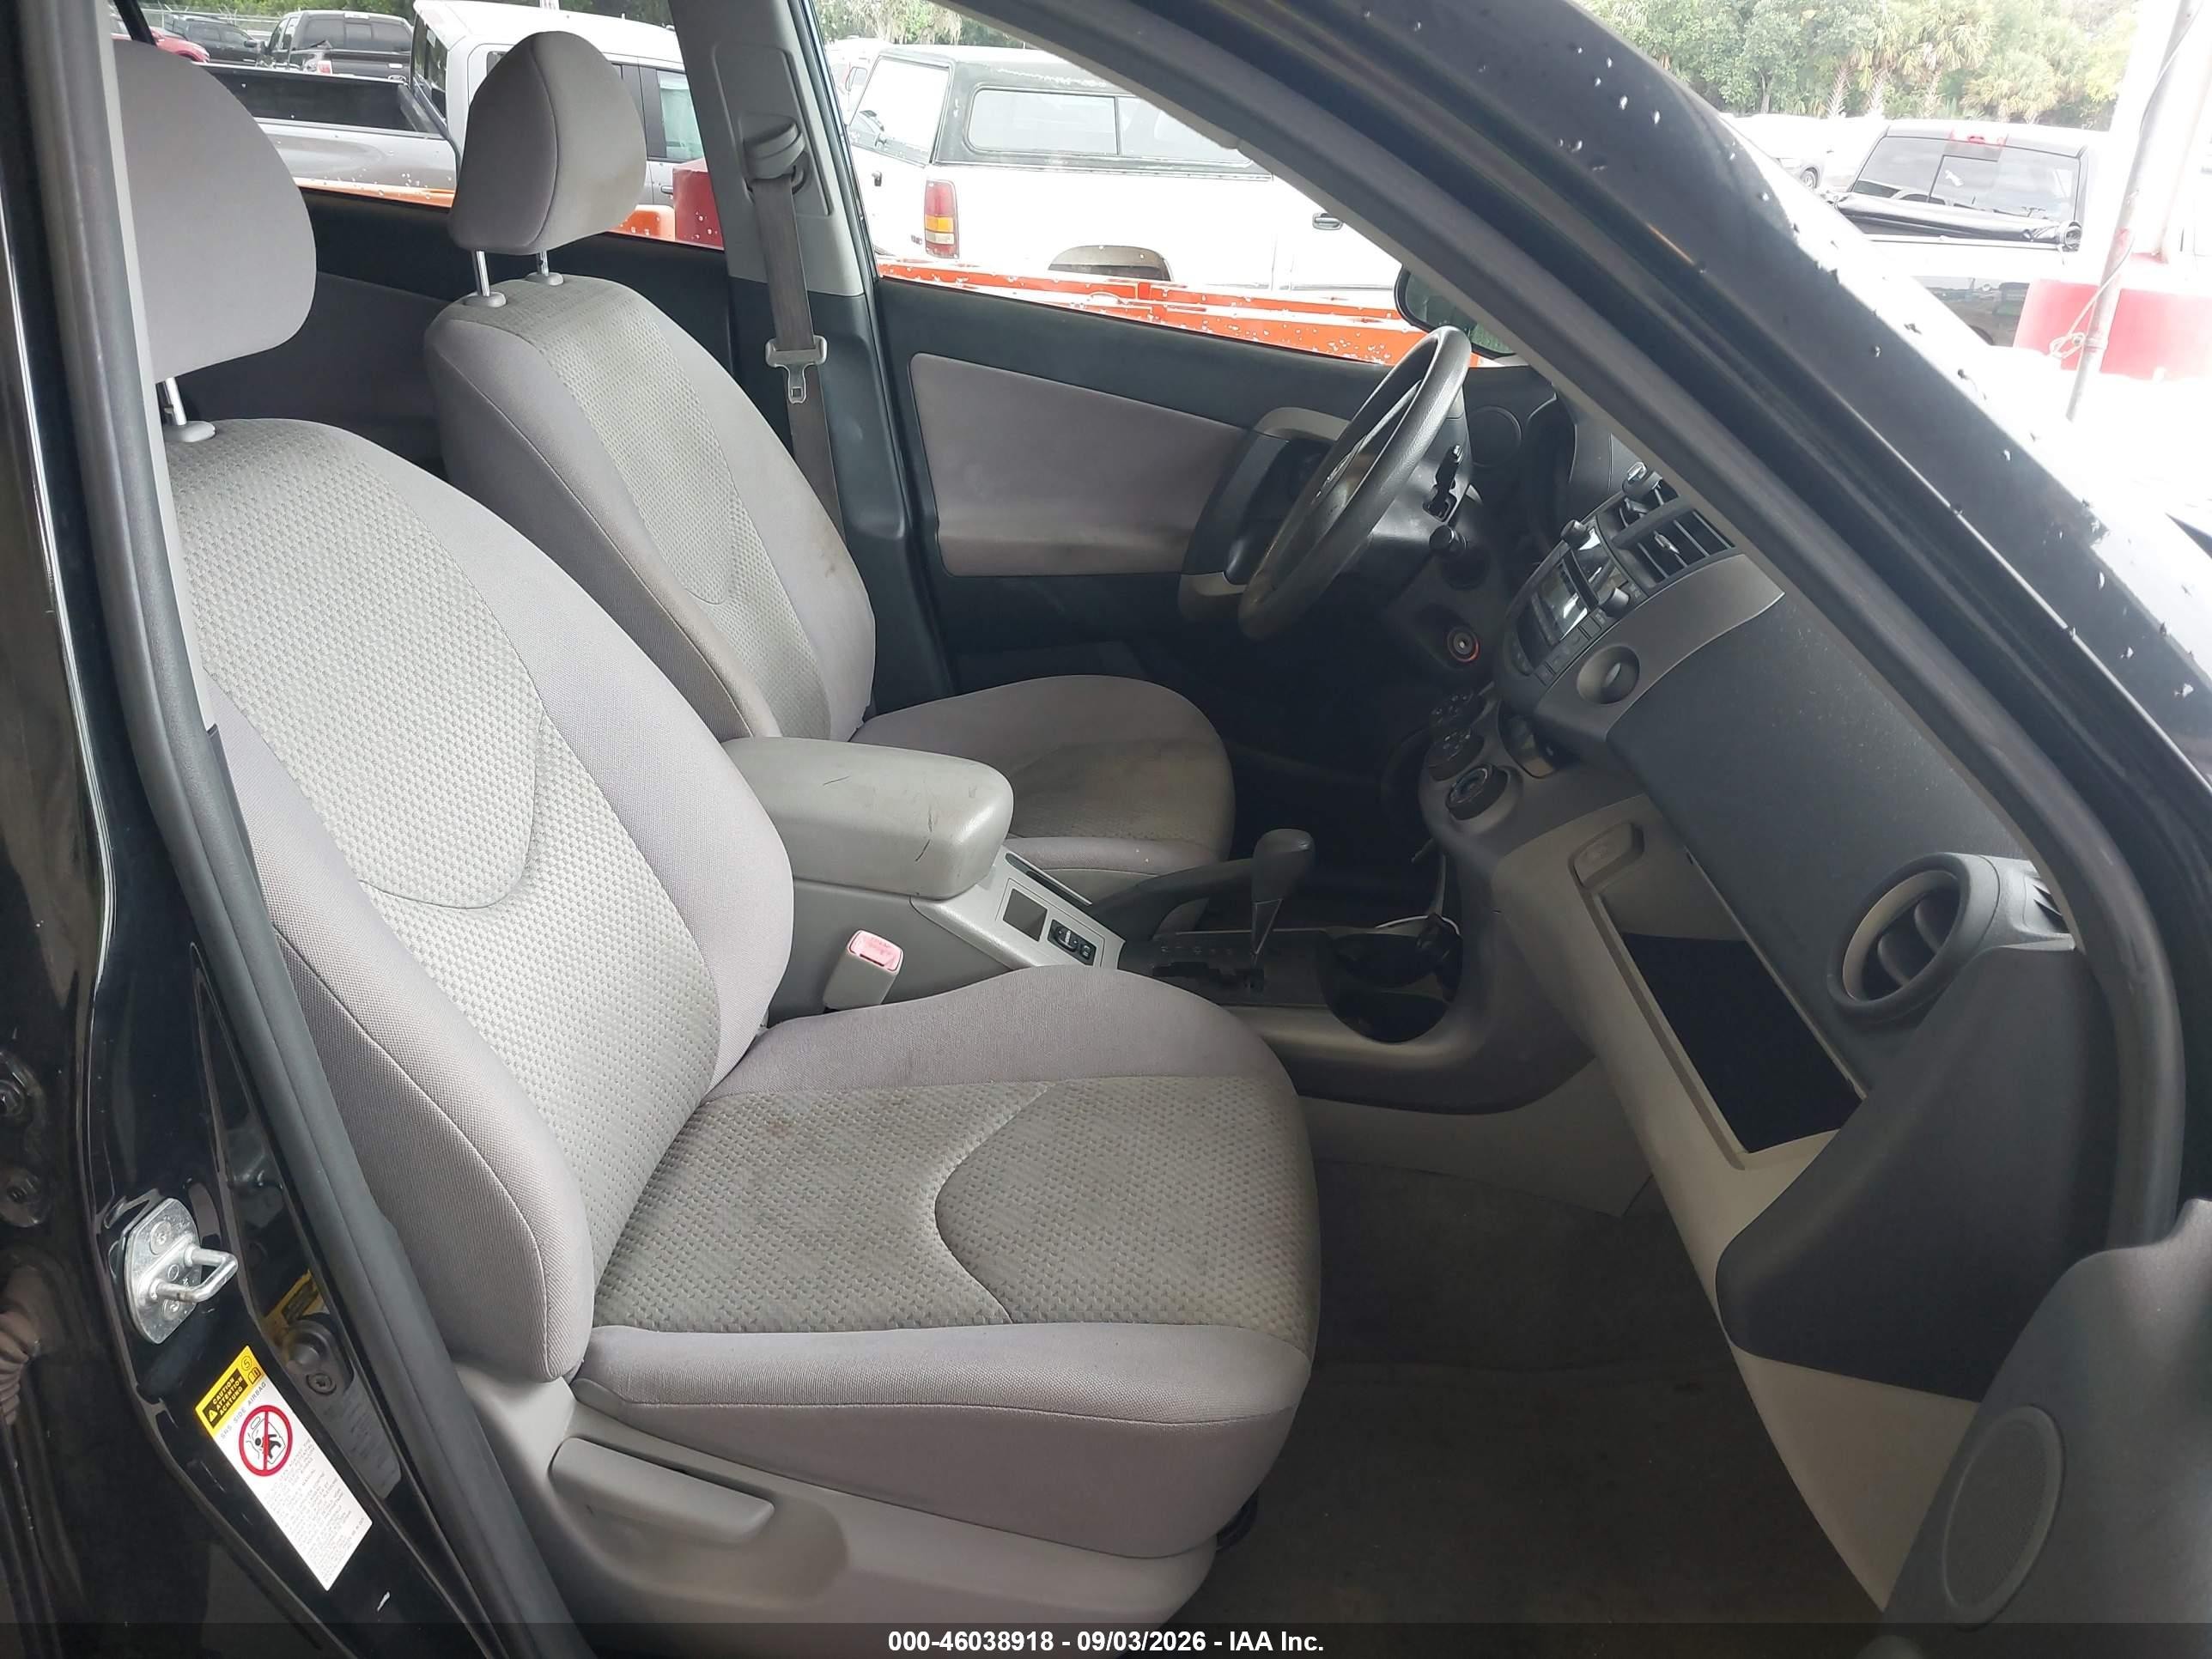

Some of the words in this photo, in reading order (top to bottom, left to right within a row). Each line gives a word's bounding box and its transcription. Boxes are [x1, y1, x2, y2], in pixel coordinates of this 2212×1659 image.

[213, 1377, 235, 1405] CAUTION
[216, 1376, 243, 1410] ATTENTION
[220, 1387, 243, 1416] ACHTUNG
[247, 1382, 267, 1406] AIRBAG
